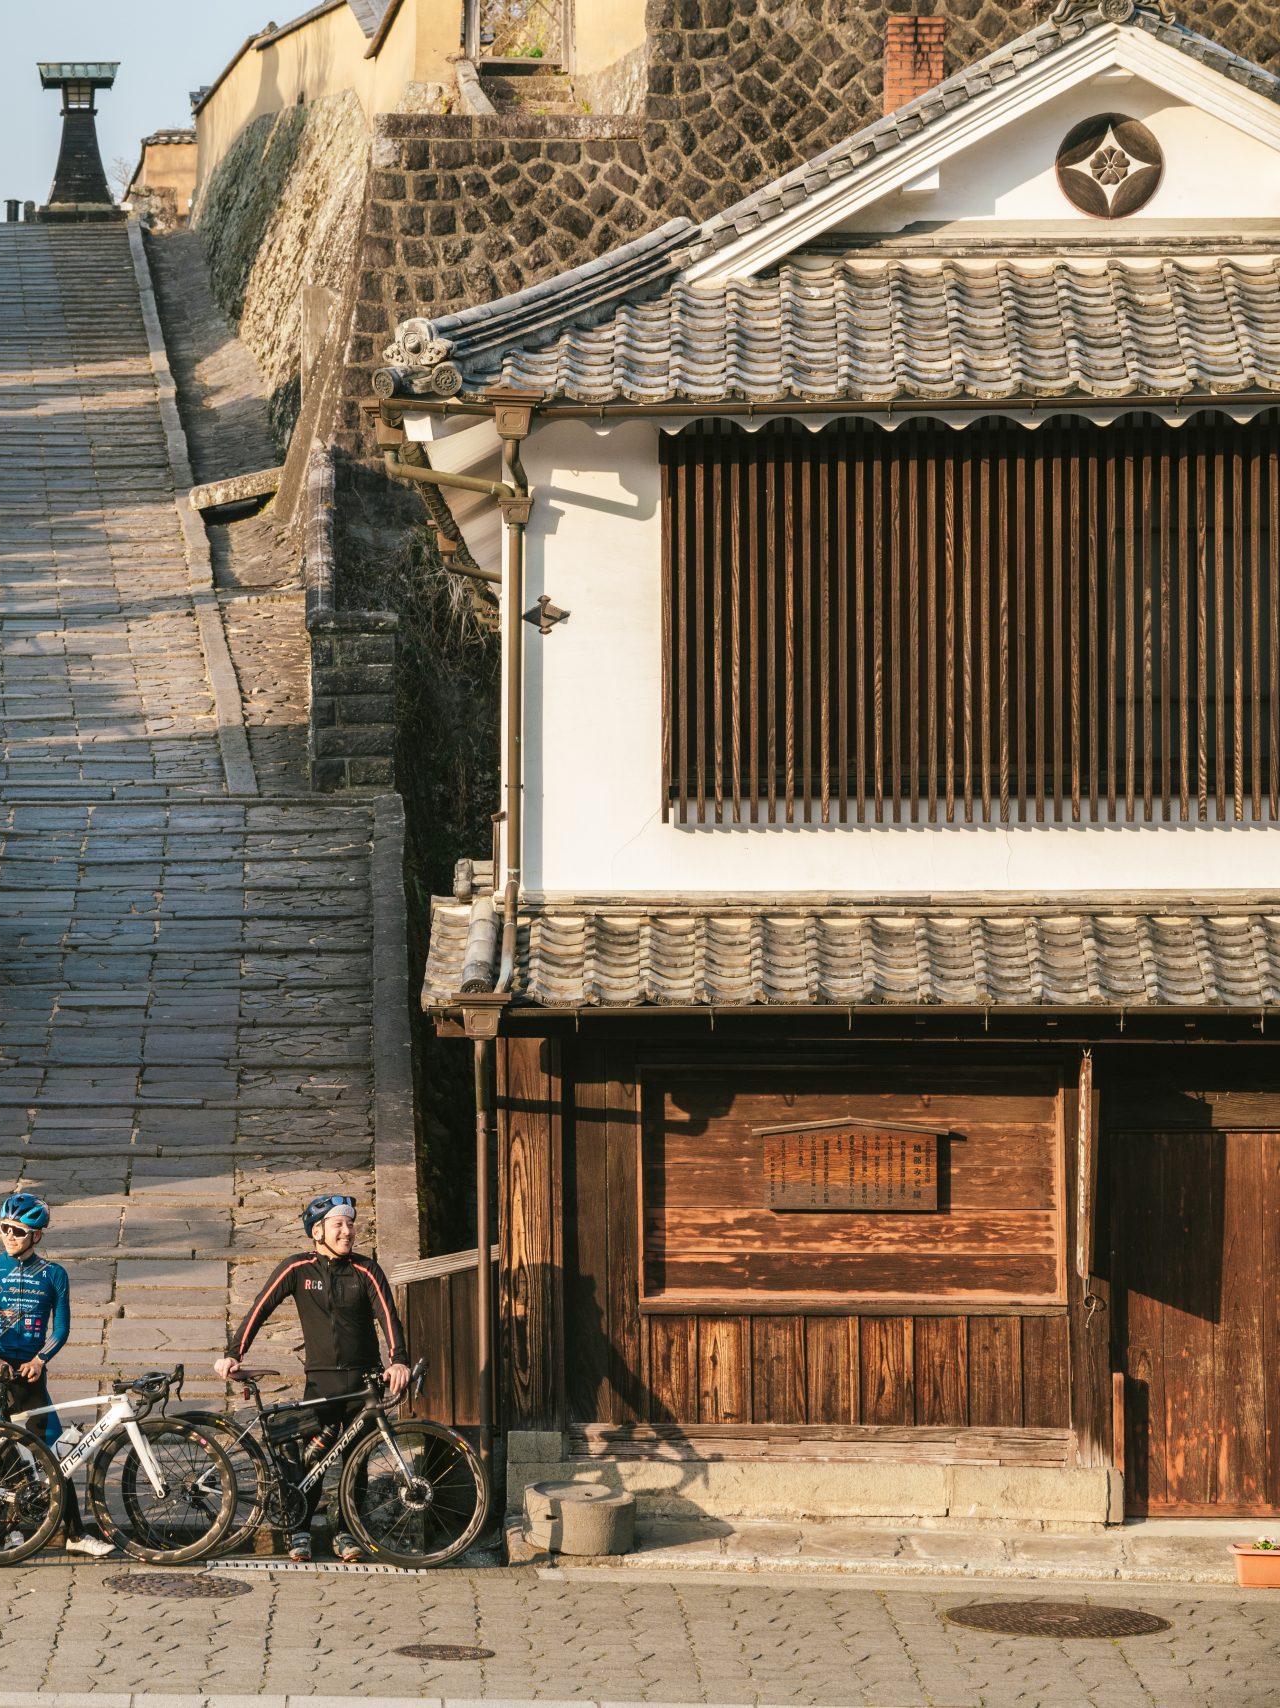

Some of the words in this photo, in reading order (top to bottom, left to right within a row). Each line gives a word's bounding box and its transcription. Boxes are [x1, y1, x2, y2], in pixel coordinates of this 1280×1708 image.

[304, 1279, 323, 1290] RCC
[61, 1421, 110, 1474] INSPACE
[303, 1419, 364, 1494] cannondale
